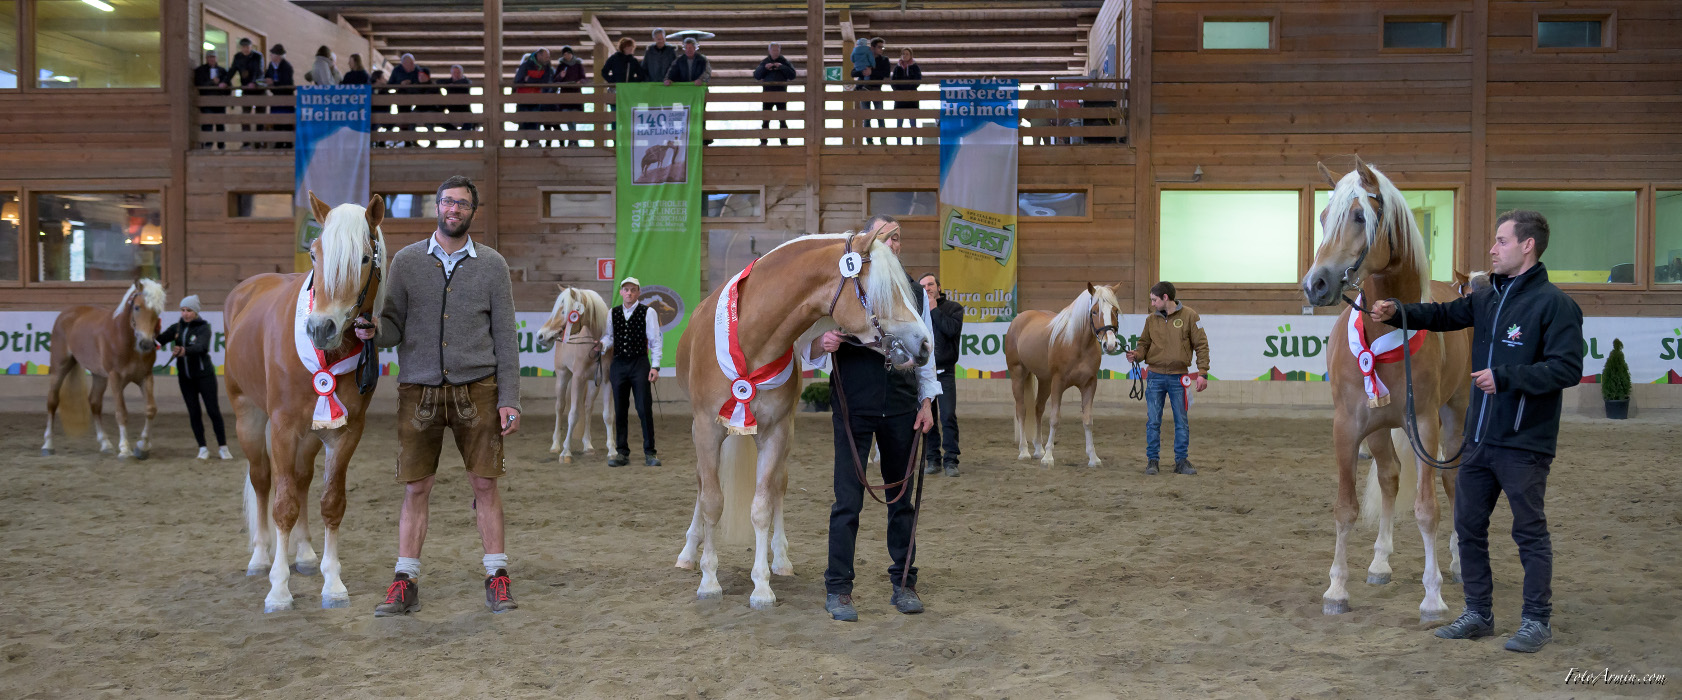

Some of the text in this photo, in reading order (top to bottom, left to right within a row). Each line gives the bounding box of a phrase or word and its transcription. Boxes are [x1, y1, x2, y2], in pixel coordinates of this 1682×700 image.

[301, 94, 368, 105] unserer
[945, 88, 1015, 100] unserer
[301, 107, 367, 122] Heimat
[945, 102, 1015, 116] Heimat
[637, 113, 667, 128] 140
[948, 222, 1010, 253] FORST
[845, 256, 855, 272] 6
[944, 289, 1013, 303] Birra allo
[980, 305, 1013, 319] puro
